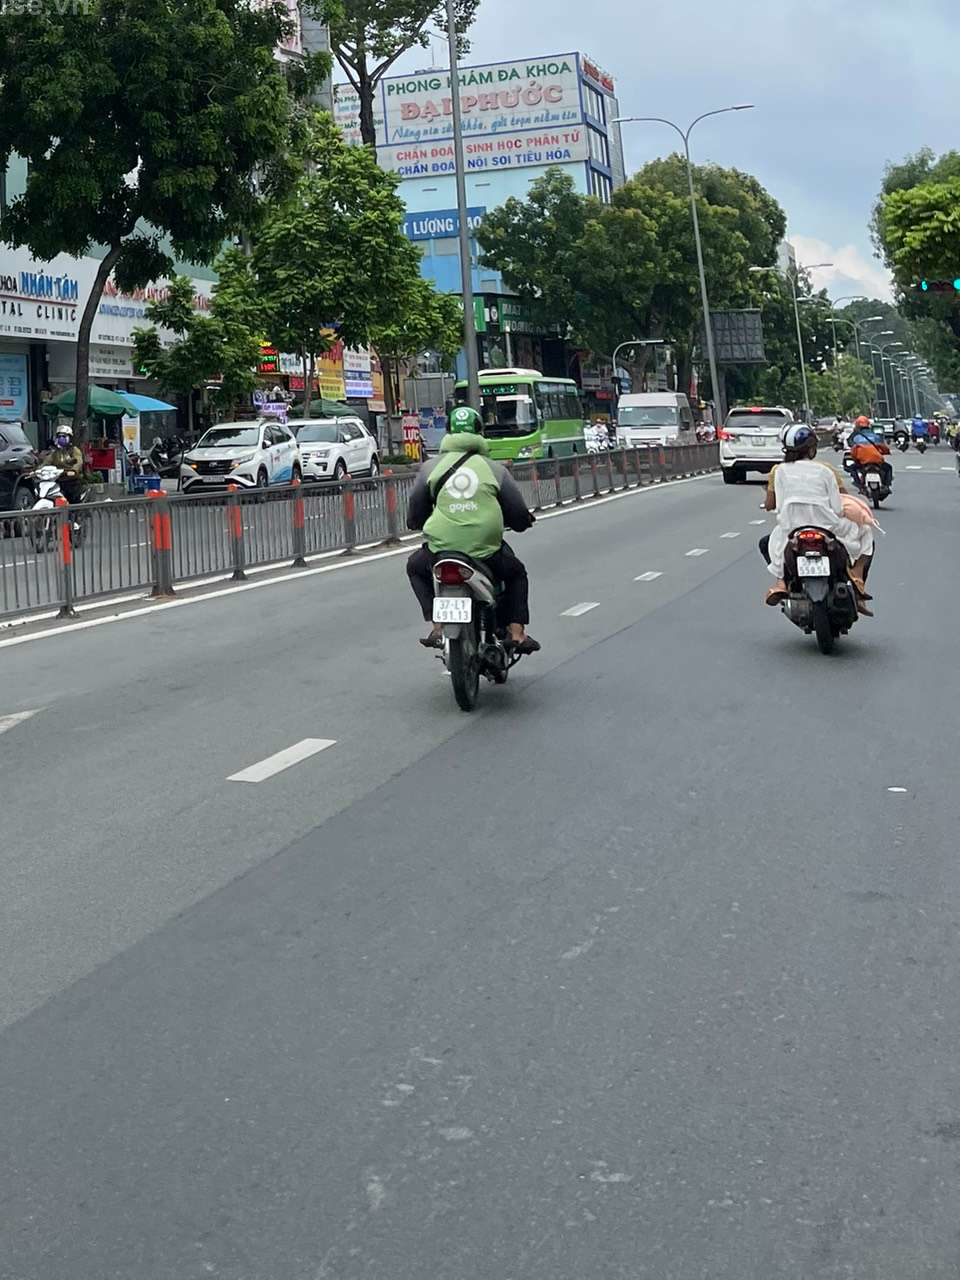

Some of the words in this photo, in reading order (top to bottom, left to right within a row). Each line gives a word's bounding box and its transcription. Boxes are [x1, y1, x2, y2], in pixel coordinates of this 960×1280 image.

[497, 69, 521, 82] ĐA
[526, 61, 572, 79] KHOA
[460, 80, 563, 115] PHƯỚC
[431, 146, 454, 157] ĐOÁ
[466, 142, 493, 154] SINH
[497, 139, 522, 152] HỌC
[491, 154, 512, 165] SOI
[413, 216, 454, 237] LƯỢNG
[456, 215, 482, 231] AO
[36, 304, 77, 322] CLINIC
